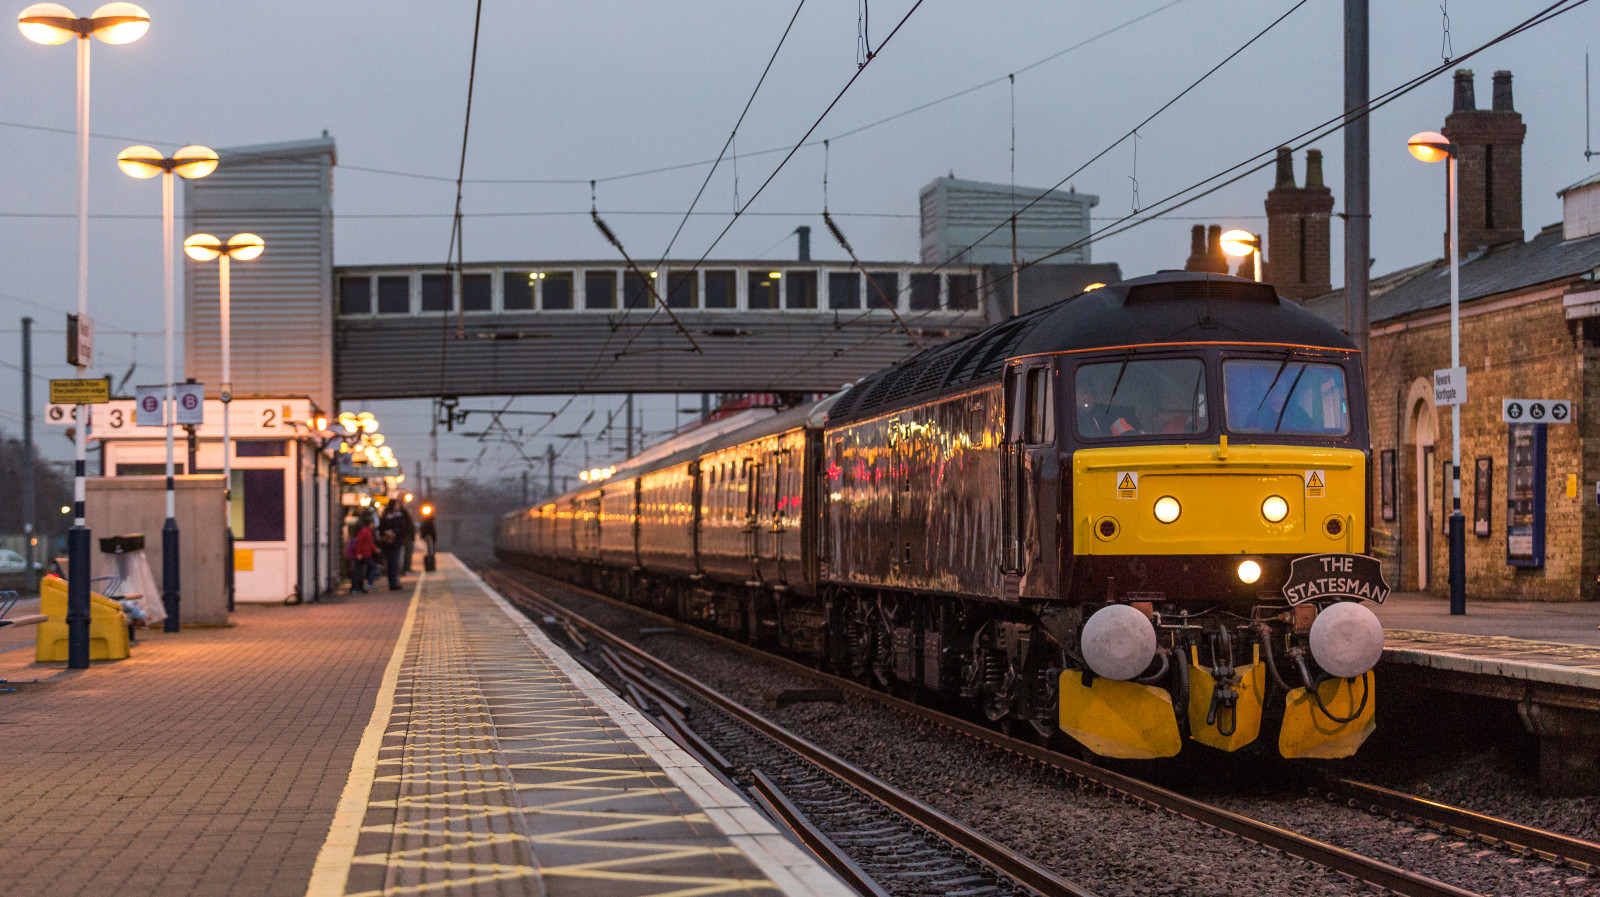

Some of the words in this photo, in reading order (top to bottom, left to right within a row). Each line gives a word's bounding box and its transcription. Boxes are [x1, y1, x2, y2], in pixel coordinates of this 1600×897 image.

[1436, 373, 1451, 386] Newark
[1436, 387, 1457, 402] Northgate
[110, 409, 123, 429] 3
[262, 409, 276, 428] 2
[1320, 557, 1354, 573] THE
[1287, 577, 1387, 603] STATESMAN
